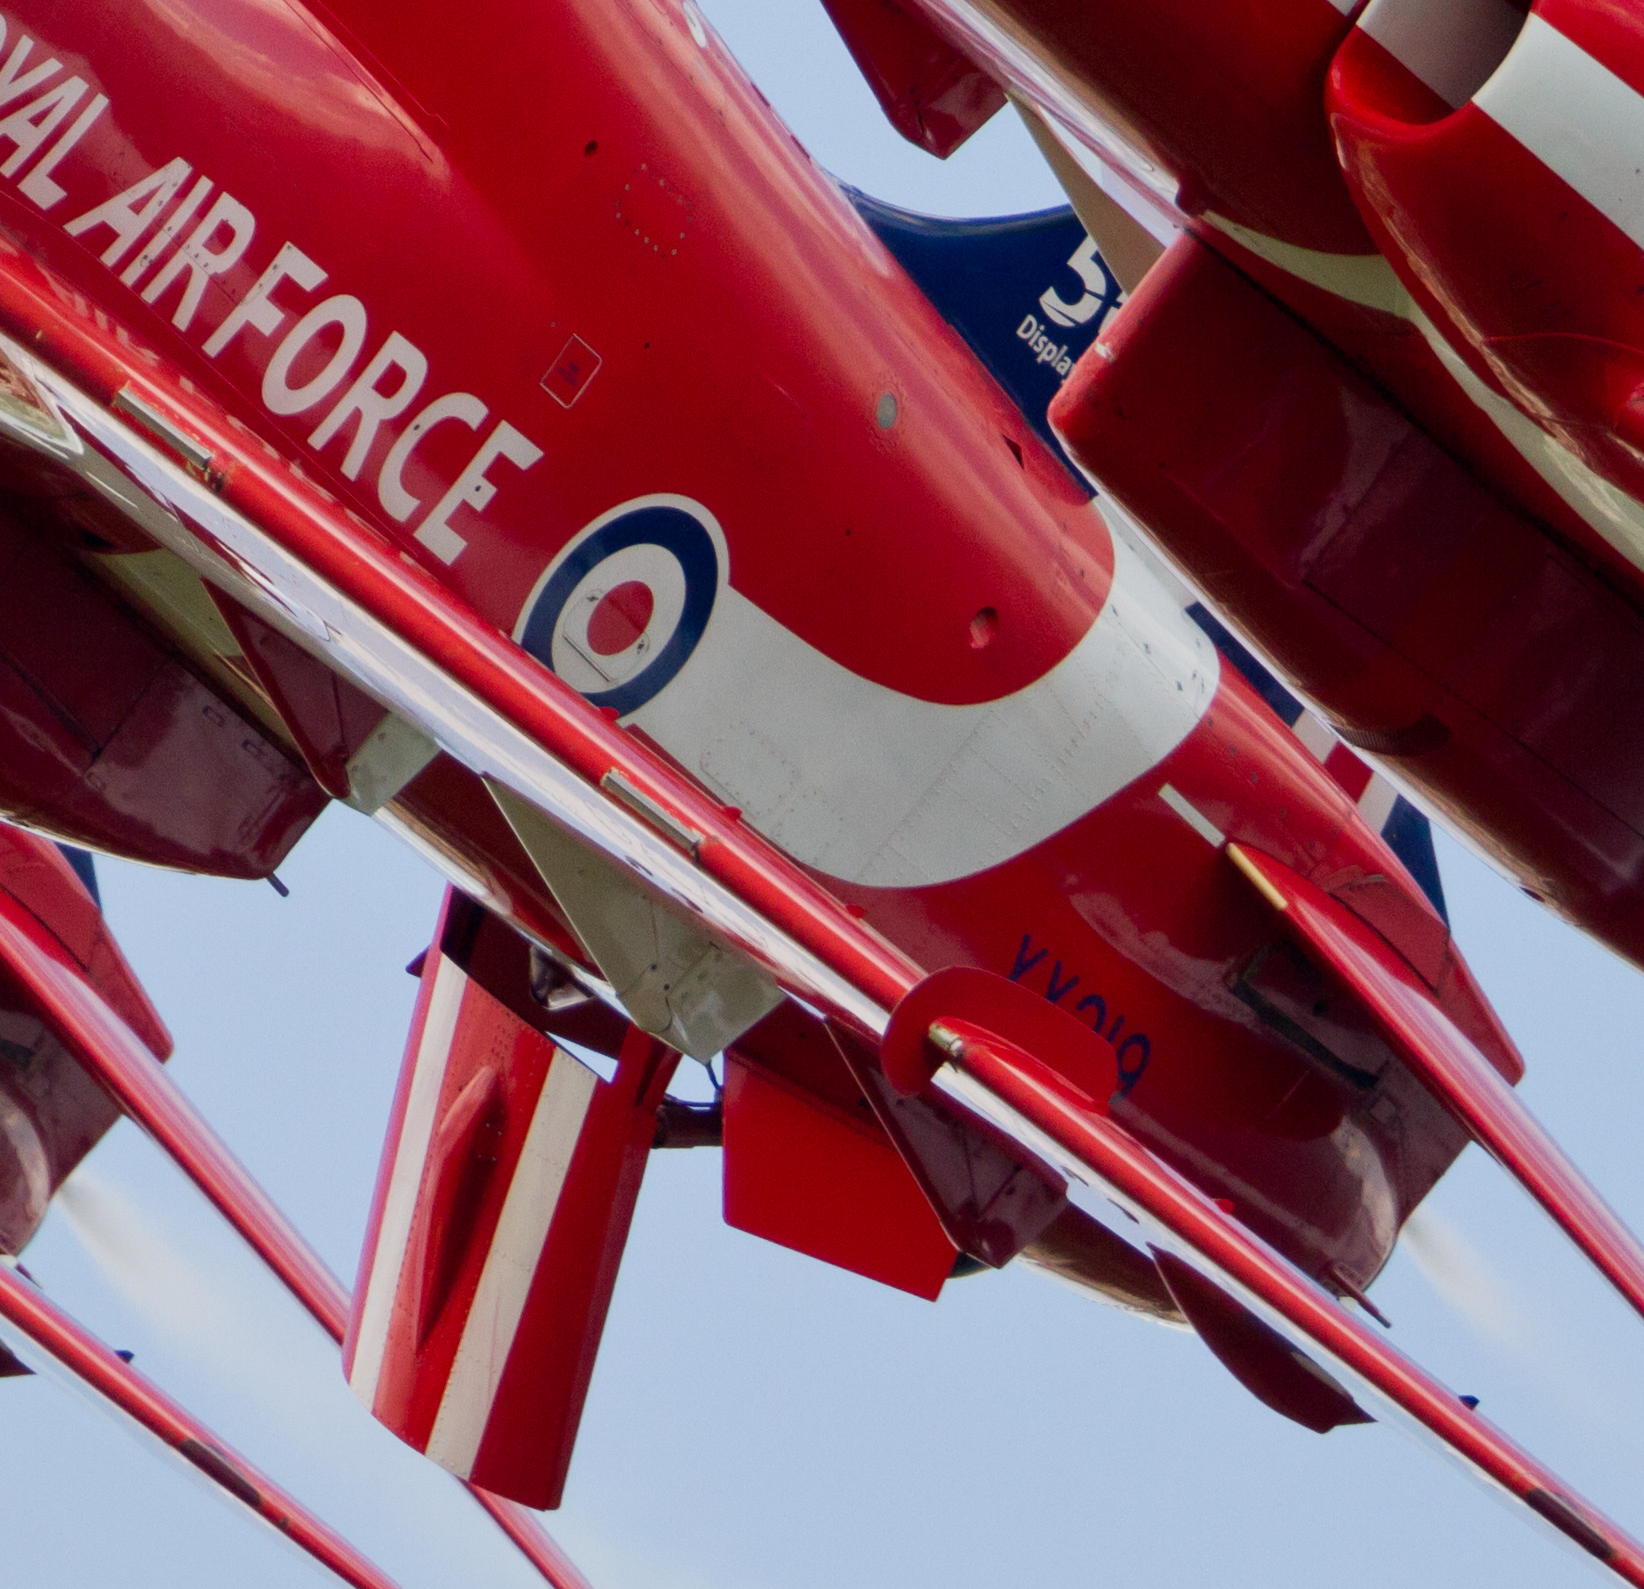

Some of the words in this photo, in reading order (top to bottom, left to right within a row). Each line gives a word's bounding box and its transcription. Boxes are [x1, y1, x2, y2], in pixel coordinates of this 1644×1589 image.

[1039, 234, 1129, 334] 5
[64, 156, 256, 331] AIR
[202, 241, 543, 567] FORCE
[1016, 314, 1076, 385] Displa
